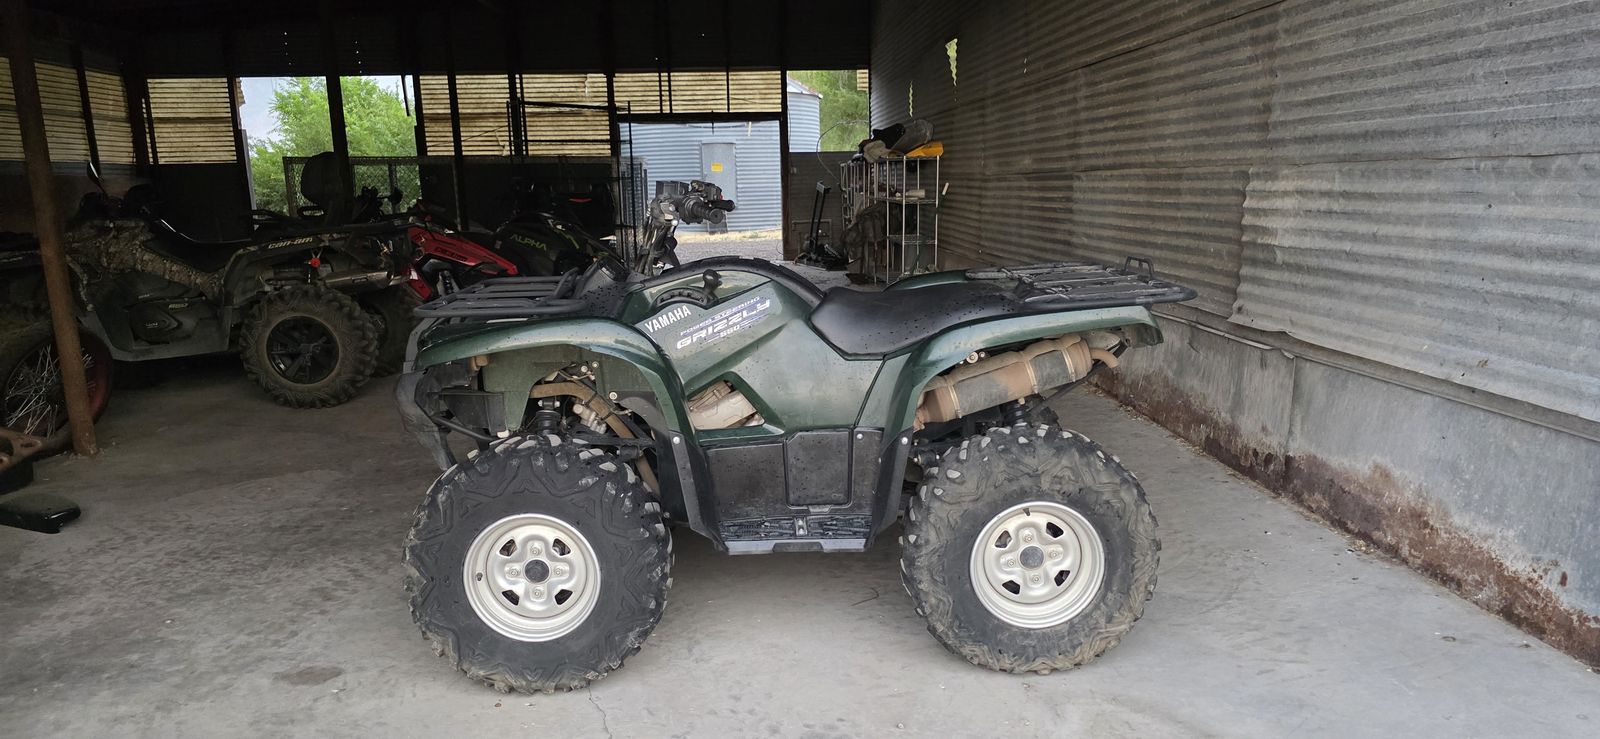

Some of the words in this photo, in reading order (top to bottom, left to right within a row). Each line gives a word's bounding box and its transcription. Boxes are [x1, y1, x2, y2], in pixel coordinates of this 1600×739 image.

[510, 234, 547, 251] ALPHA
[645, 305, 691, 333] YAMAHA
[676, 299, 770, 349] GRIZZLY
